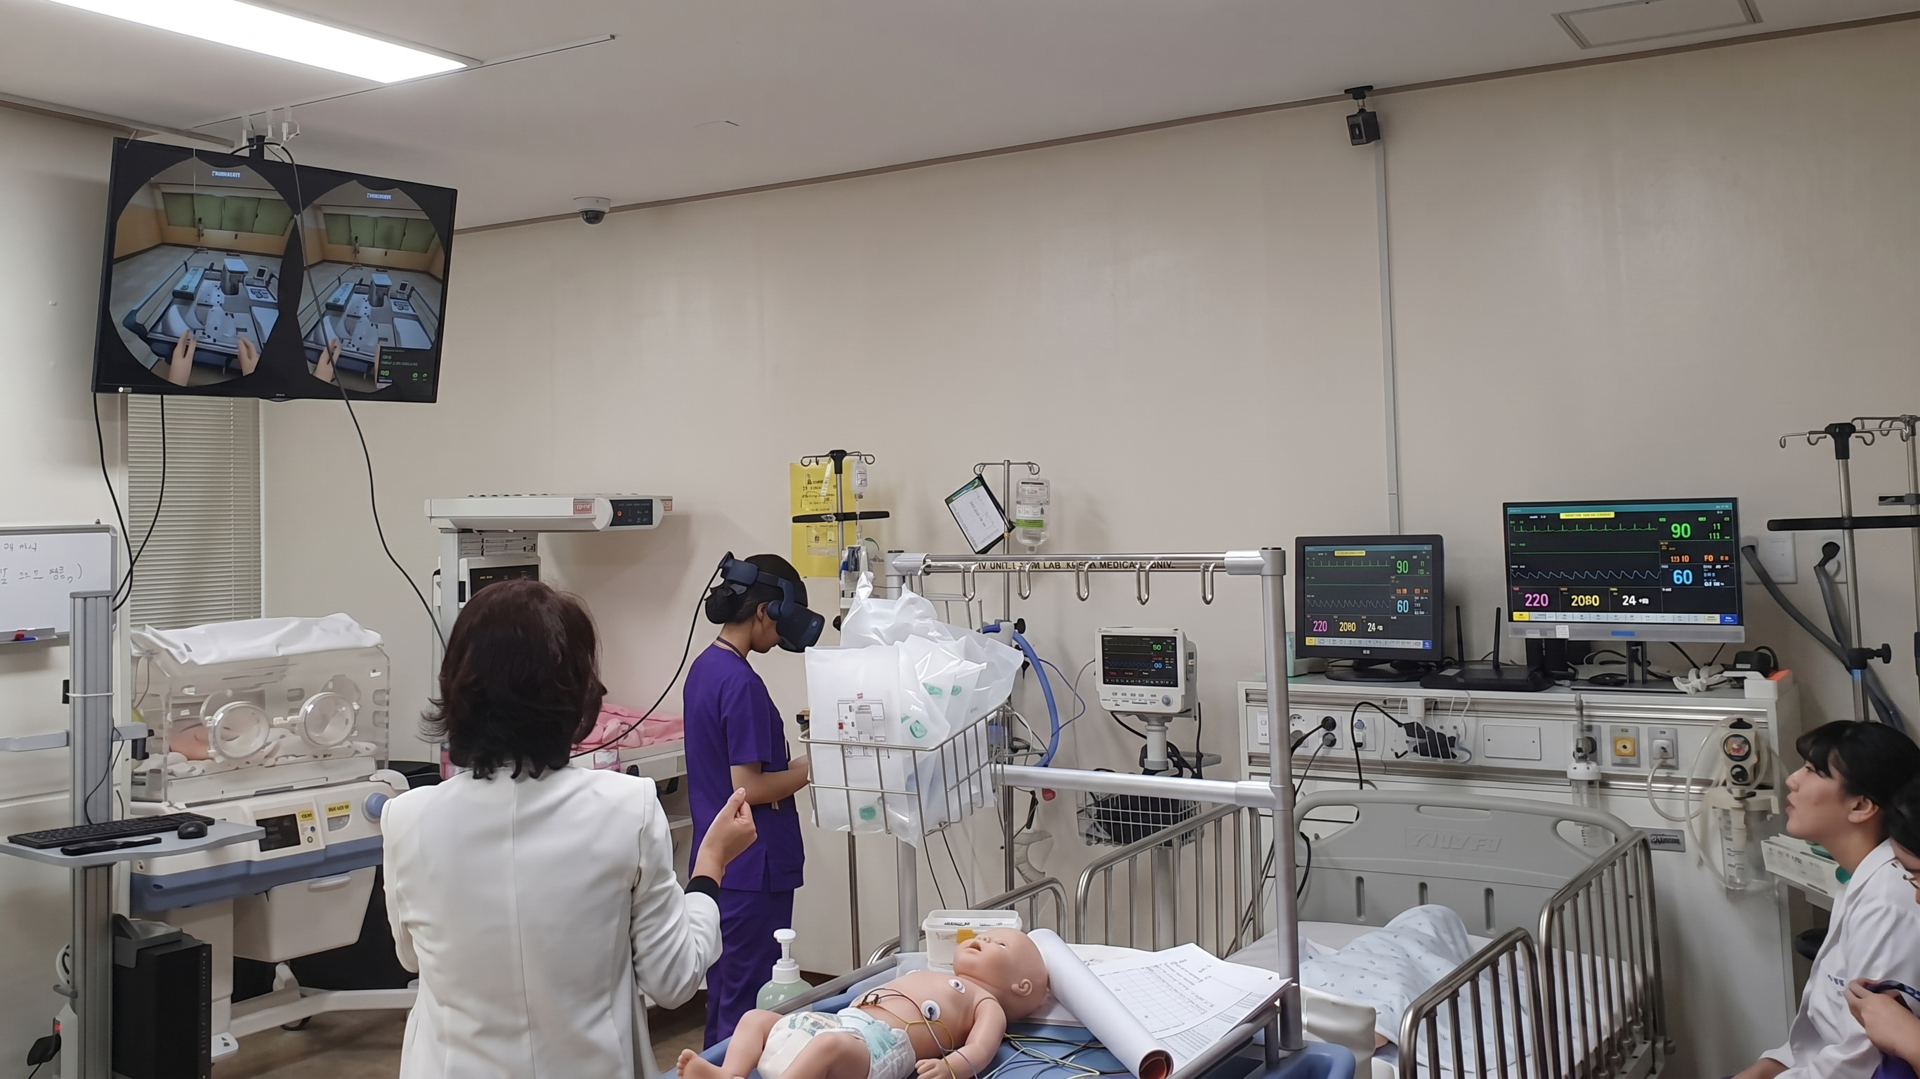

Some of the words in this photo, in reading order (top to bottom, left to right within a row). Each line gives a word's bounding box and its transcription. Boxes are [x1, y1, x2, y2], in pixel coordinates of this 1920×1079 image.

[1671, 523, 1691, 538] 90
[1396, 560, 1409, 574] 90
[1673, 569, 1693, 584] 60
[1396, 599, 1409, 613] 60
[1525, 593, 1549, 607] 220
[1313, 620, 1328, 632] 220
